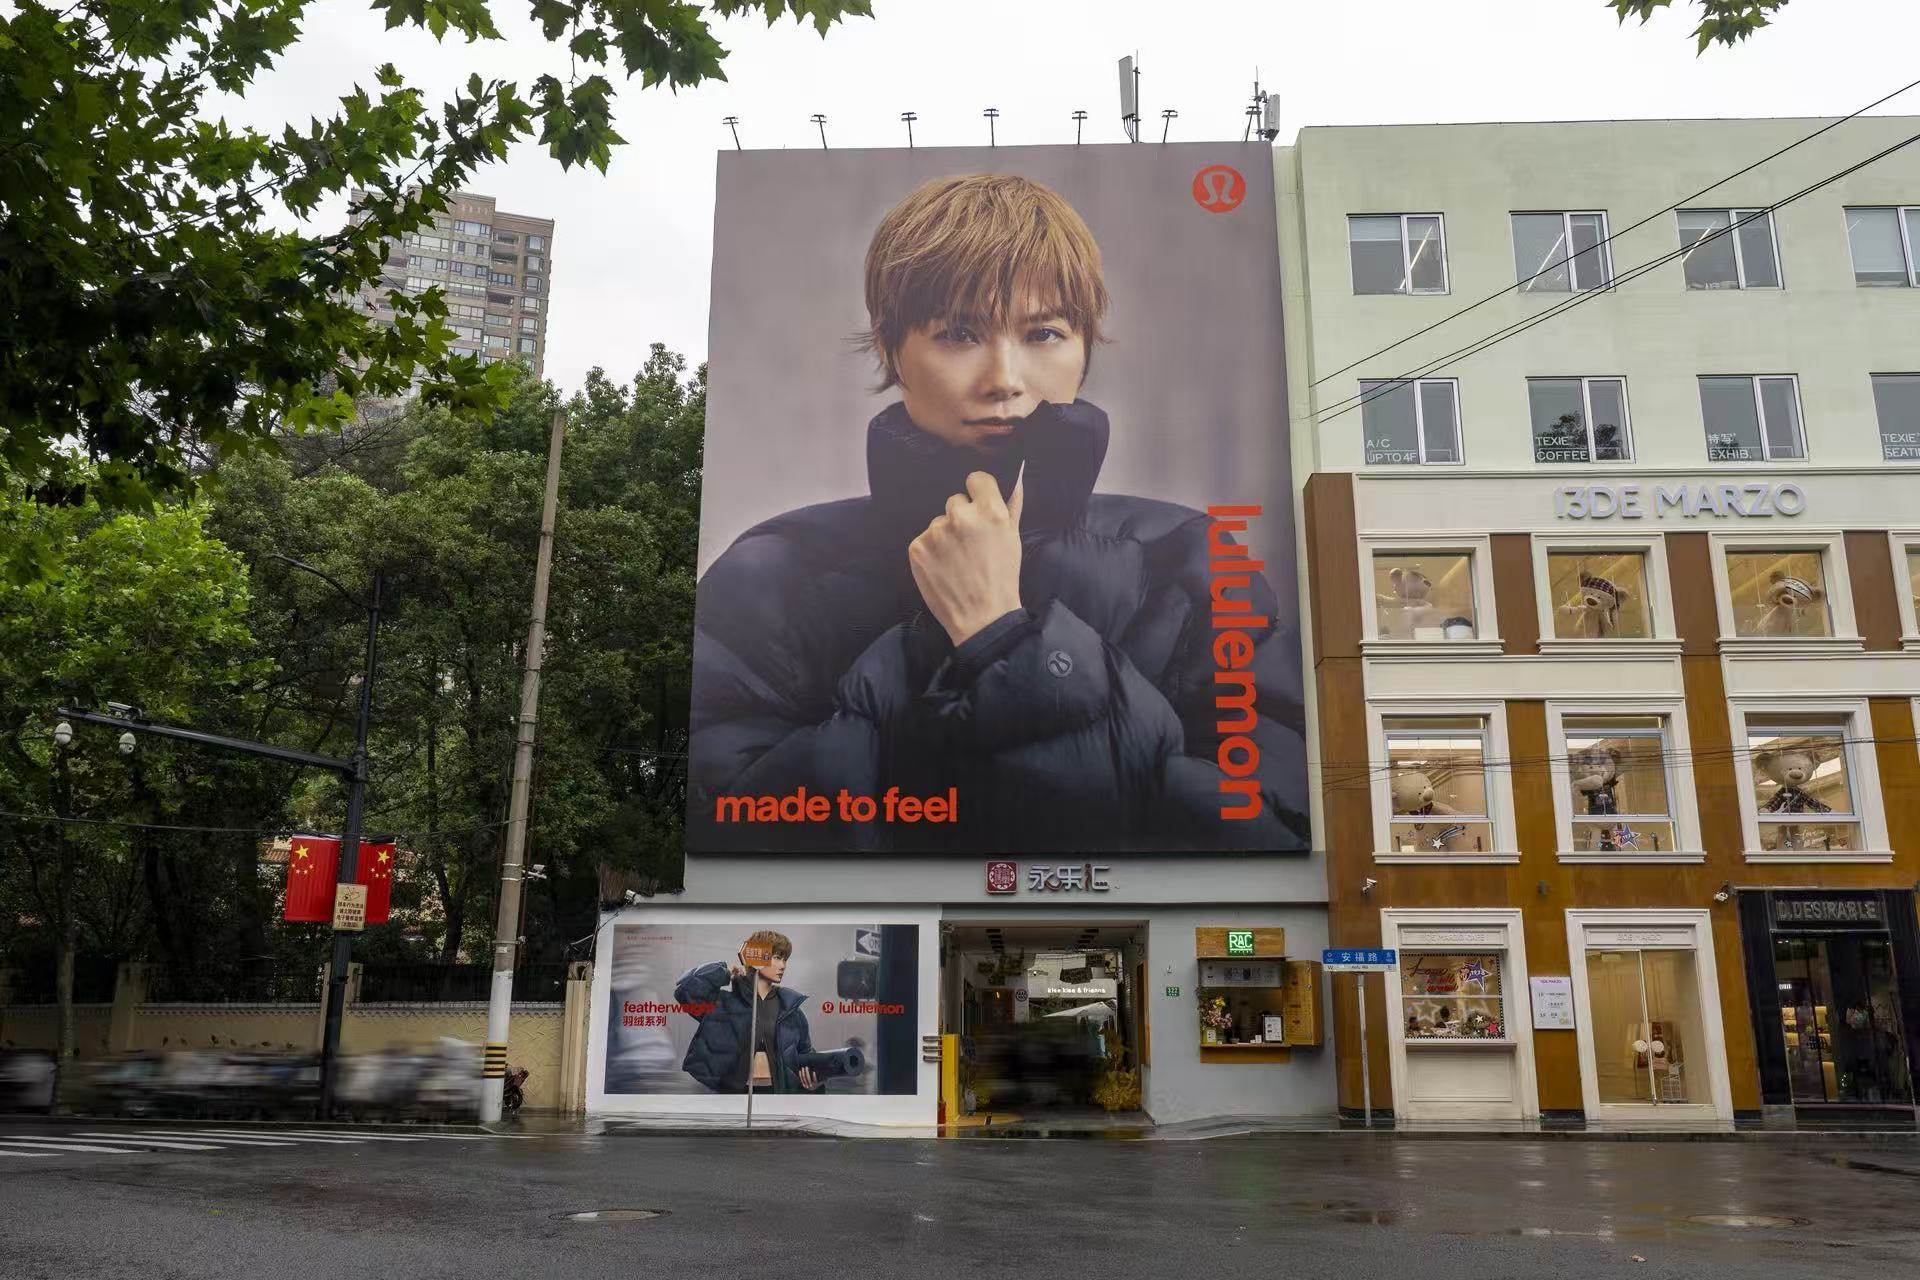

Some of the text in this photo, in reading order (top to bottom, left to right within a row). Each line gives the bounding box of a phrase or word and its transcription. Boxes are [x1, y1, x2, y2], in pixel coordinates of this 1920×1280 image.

[1536, 436, 1569, 446] TEXIE
[1882, 433, 1917, 443] TEXIE
[1367, 452, 1417, 463] UP TO 4F
[1536, 450, 1588, 461] COFFEE
[1709, 449, 1752, 459] EXHIB.
[1553, 482, 1806, 518] 13DE MARZO
[1207, 505, 1268, 820] lululemon
[716, 787, 957, 822] made to feel
[1028, 864, 1110, 891] 永乐汇
[1229, 934, 1253, 949] RAC
[1341, 951, 1378, 962] 安福路
[839, 1002, 905, 1014] lululemon
[623, 1015, 667, 1027] 羽绒系列
